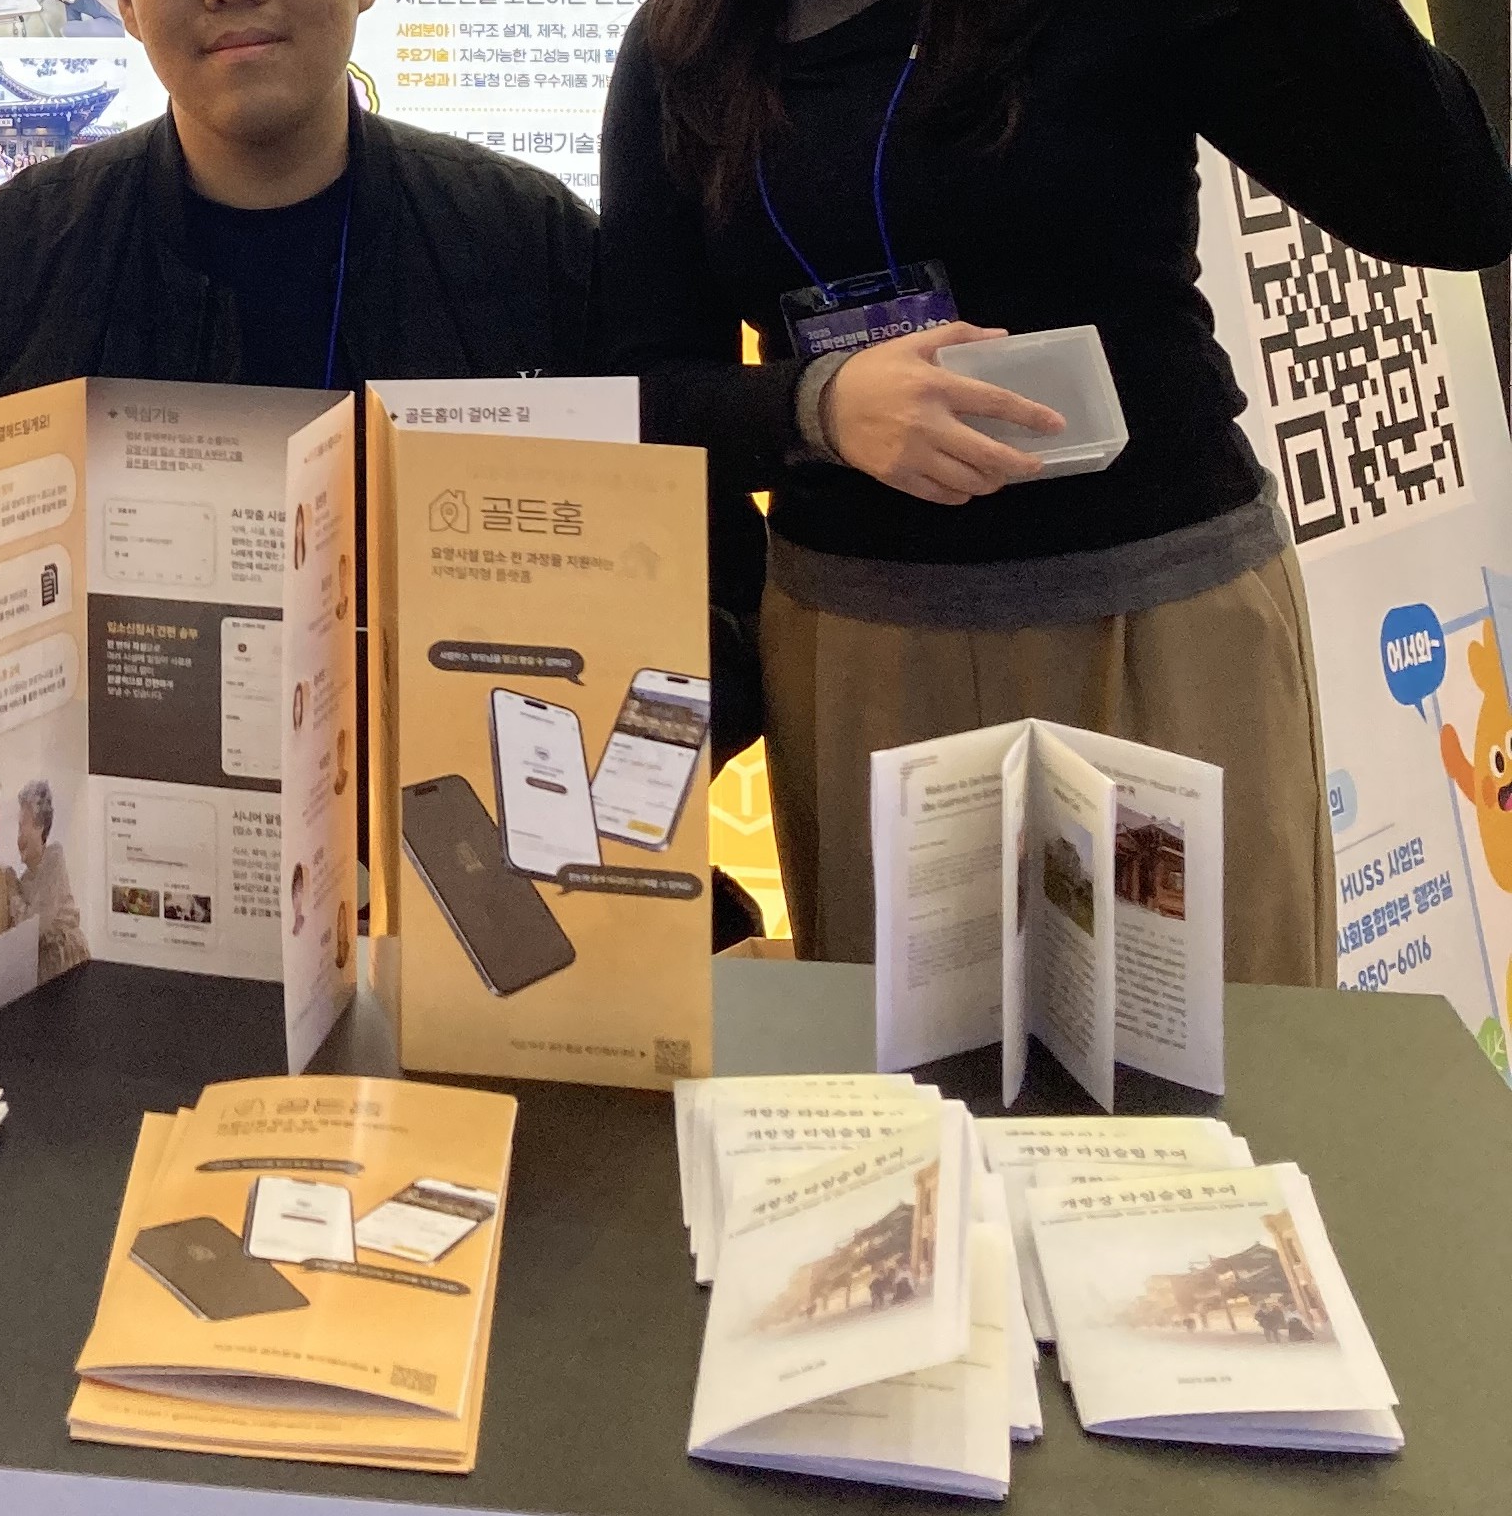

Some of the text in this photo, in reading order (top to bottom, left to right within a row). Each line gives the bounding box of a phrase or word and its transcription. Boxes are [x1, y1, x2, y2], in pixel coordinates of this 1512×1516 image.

[869, 321, 913, 341] EXPO
[406, 406, 530, 424] 골든홈이 걸어온 길
[480, 496, 584, 536] 골든홈
[1340, 837, 1425, 904] HUSS 사업단
